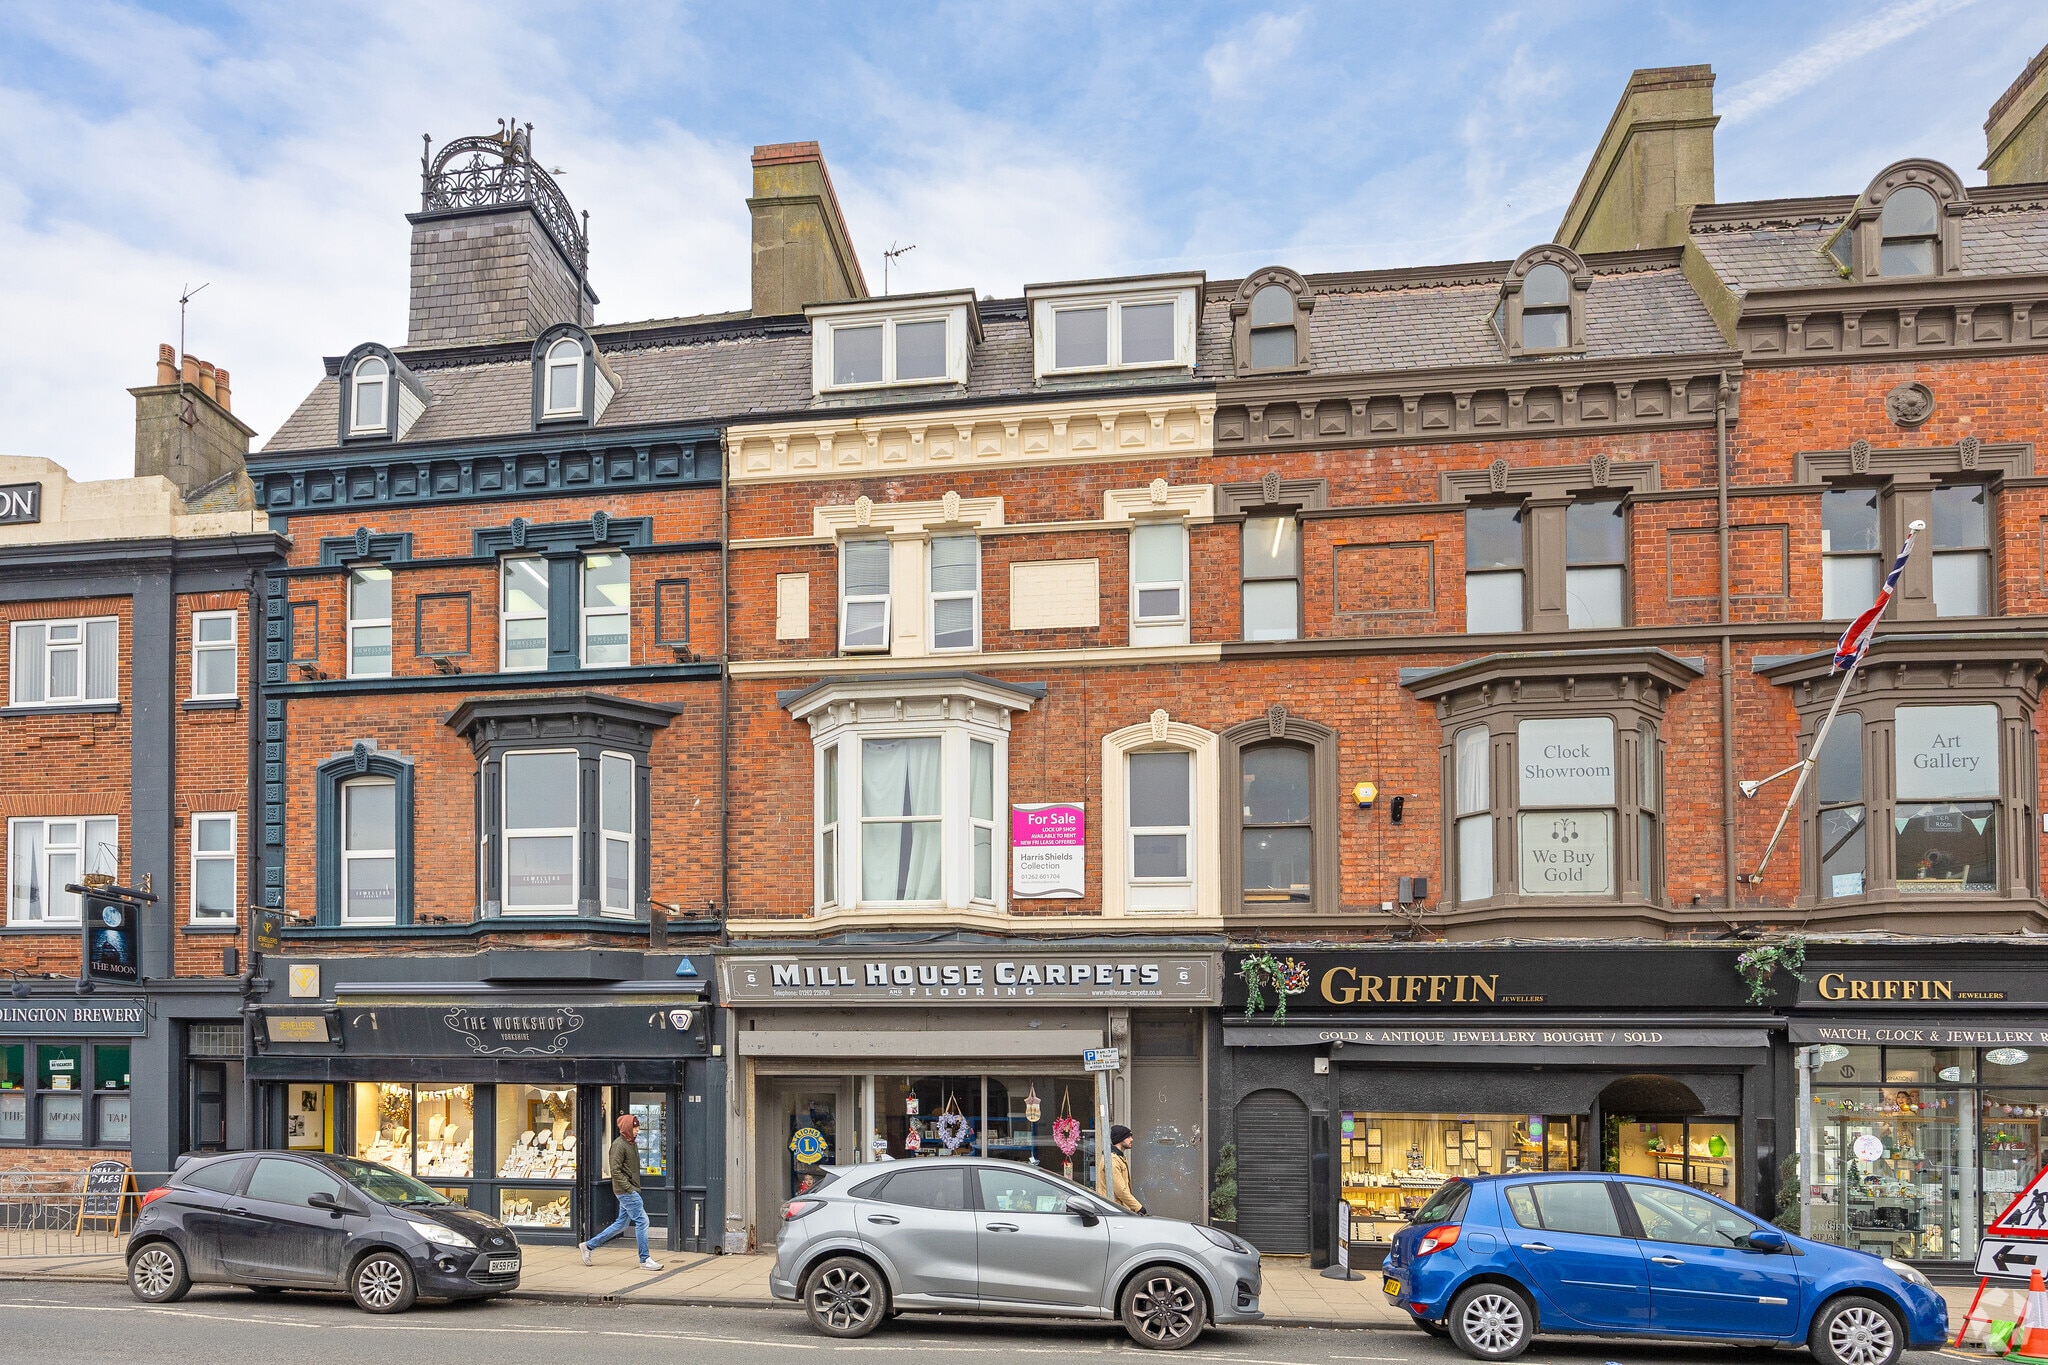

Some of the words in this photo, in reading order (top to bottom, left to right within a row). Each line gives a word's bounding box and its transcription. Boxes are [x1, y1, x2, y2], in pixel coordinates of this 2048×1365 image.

[1931, 733, 1961, 748] Art
[1543, 744, 1591, 759] Clock
[1913, 753, 1980, 771] Gallery
[1525, 765, 1610, 779] Showroom
[1028, 814, 1047, 824] For
[1050, 813, 1076, 824] Sale
[1020, 853, 1044, 861] Harris
[1045, 852, 1073, 860] Shields
[1533, 849, 1557, 863] We
[1563, 849, 1595, 866] Buy
[1020, 862, 1060, 870] Collection
[1544, 867, 1584, 882] Gold
[91, 961, 110, 971] THE
[110, 964, 136, 974] MOON
[747, 974, 756, 982] 6
[770, 964, 856, 987] MILL
[864, 963, 983, 986] HOUSE
[994, 962, 1160, 985] CARPETS
[1178, 972, 1189, 981] 6
[909, 987, 1034, 996] FLOORING
[1320, 966, 1499, 1005] GRIFFIN
[1818, 972, 1953, 1000] GRIFFIN
[0, 1008, 67, 1021] LINGTON
[74, 1008, 143, 1022] BREWERY
[280, 1021, 315, 1030] JEWELLERS
[463, 1016, 487, 1030] THE
[492, 1016, 564, 1030] WORKSHOP
[501, 1033, 530, 1041] YORKSHIRE
[1319, 1031, 1358, 1041] GOLD
[1365, 1031, 1375, 1041] &
[1381, 1031, 1445, 1043] ANTIQUE
[1452, 1031, 1536, 1042] JEWELLERY
[1542, 1032, 1604, 1043] BOUGHT
[1610, 1032, 1616, 1042] /
[1624, 1031, 1663, 1042] SOLD
[1818, 1028, 1871, 1042] WATCH,
[1875, 1029, 1924, 1041] CLOCK
[1929, 1031, 1939, 1042] &
[1946, 1030, 2034, 1042] JEWELLERY
[1087, 1051, 1094, 1060] P
[2, 1111, 24, 1121] THE
[49, 1112, 80, 1121] MOON
[107, 1113, 128, 1122] TAP
[795, 1127, 819, 1138] LIONS
[804, 1138, 815, 1152] L
[872, 1140, 887, 1149] Open
[492, 1261, 506, 1271] BK59
[507, 1260, 518, 1270] FXF
